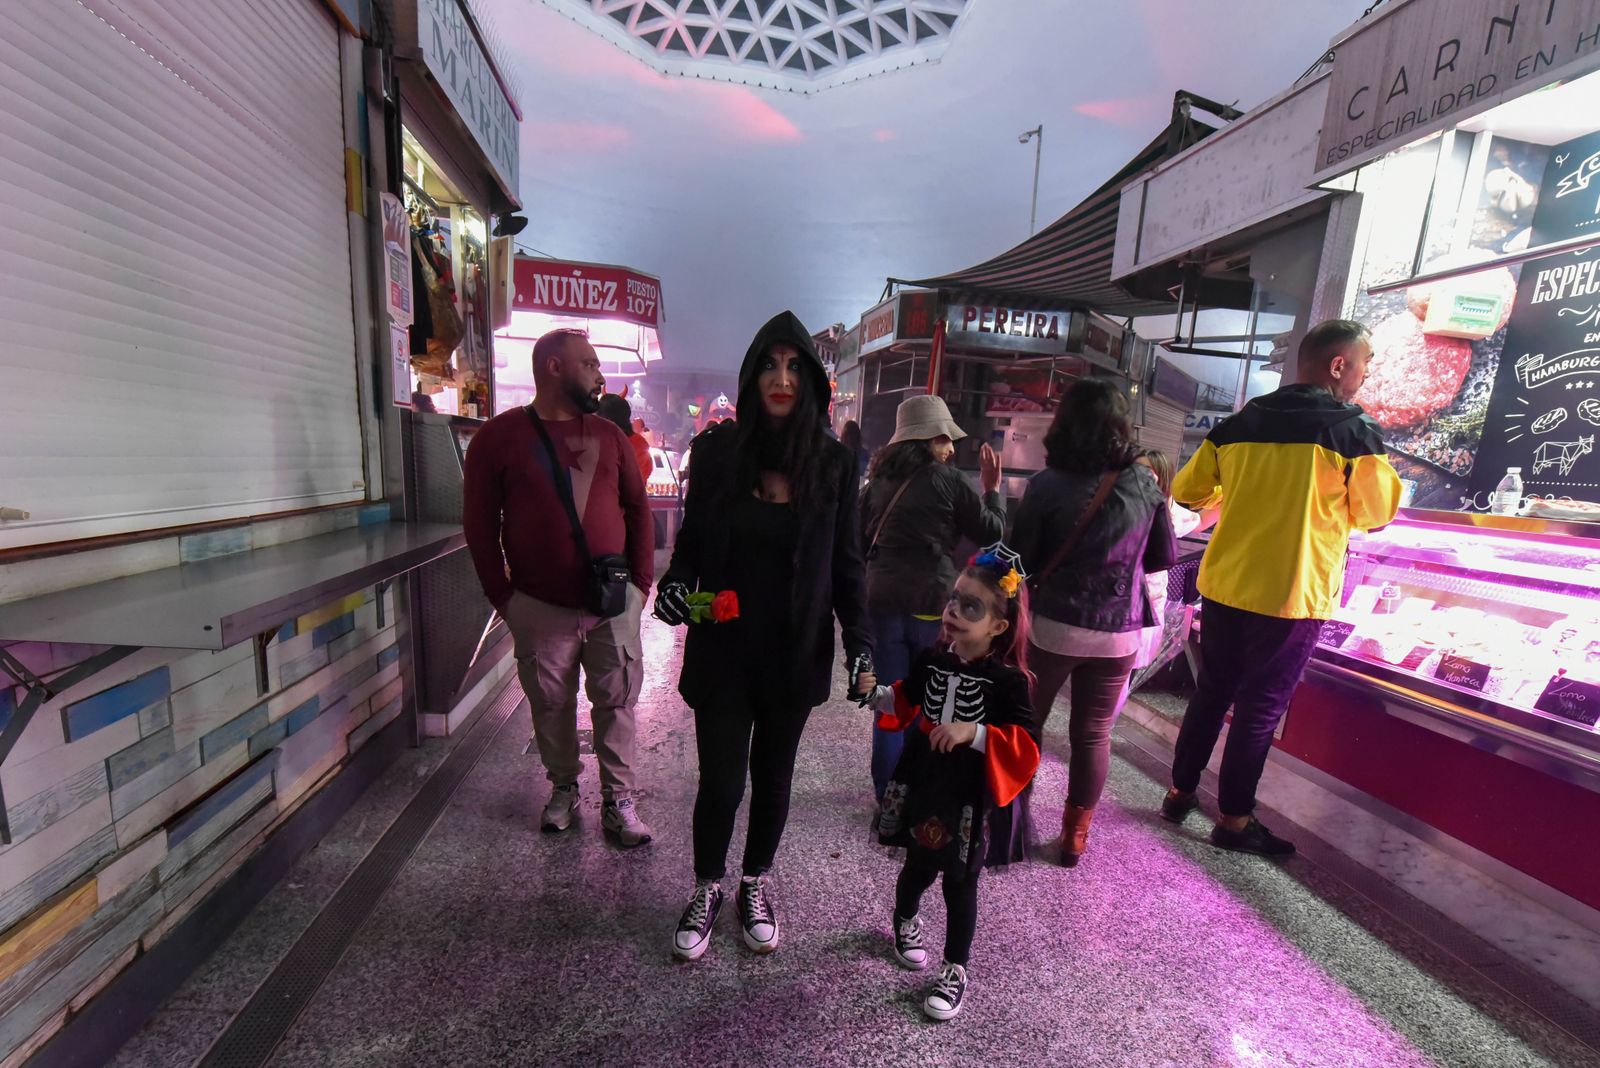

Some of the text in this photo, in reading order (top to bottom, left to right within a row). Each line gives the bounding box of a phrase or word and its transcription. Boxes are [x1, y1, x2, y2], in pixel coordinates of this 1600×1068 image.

[1326, 74, 1497, 165] ESPECIALIDAD
[1515, 44, 1557, 80] EN
[533, 269, 618, 311] NUÑEZ
[626, 278, 656, 300] PUESTO
[626, 295, 656, 317] 107
[962, 305, 1059, 340] PEREIRA
[1531, 356, 1600, 382] HAMBURG
[1547, 681, 1586, 702] Lomo
